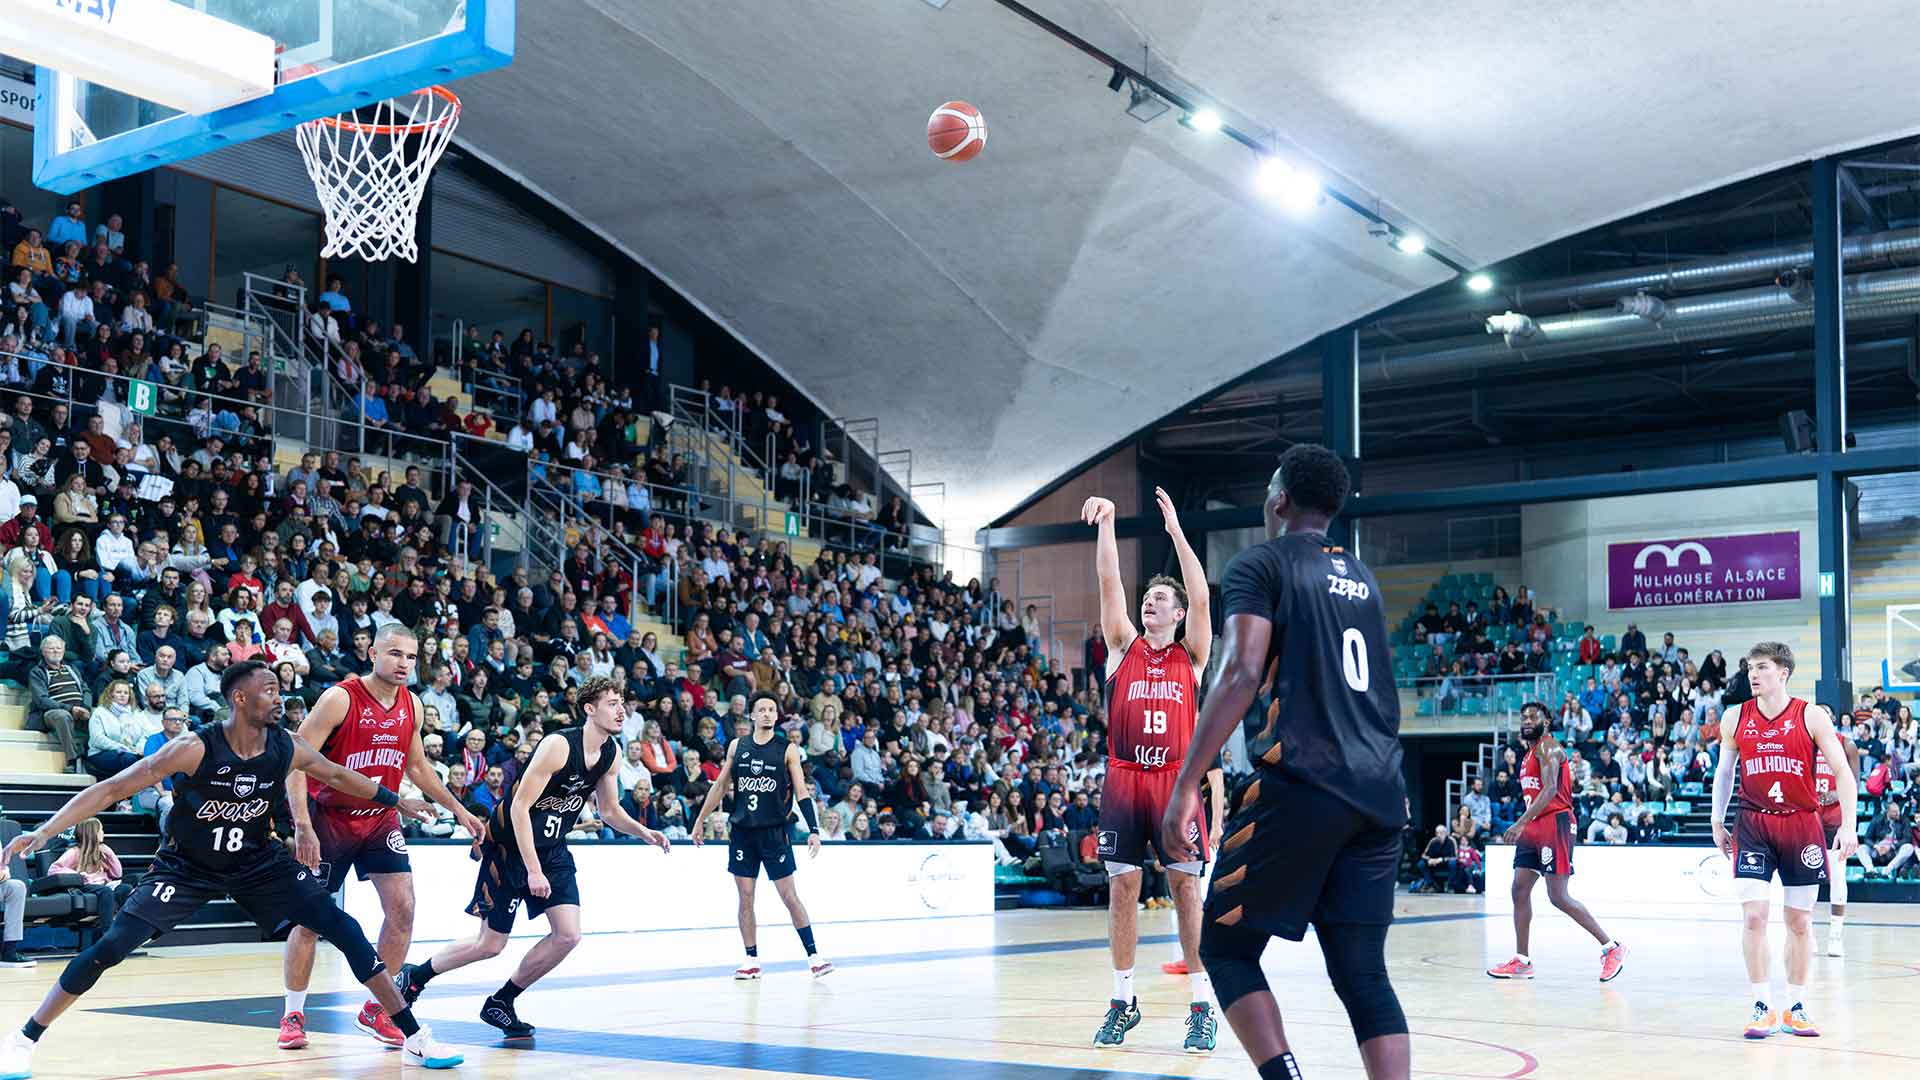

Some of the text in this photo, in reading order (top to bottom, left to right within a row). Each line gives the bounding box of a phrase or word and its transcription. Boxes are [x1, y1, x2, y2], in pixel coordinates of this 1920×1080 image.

[135, 383, 150, 410] B
[788, 515, 798, 535] A
[1327, 574, 1370, 600] ZERO
[1821, 574, 1833, 596] H
[1342, 627, 1370, 692] 0
[1143, 709, 1167, 734] 19
[747, 794, 759, 812] 3
[1767, 780, 1784, 803] 4
[543, 815, 562, 839] 51
[211, 826, 244, 852] 18
[735, 849, 744, 861] 3
[151, 881, 176, 903] 18
